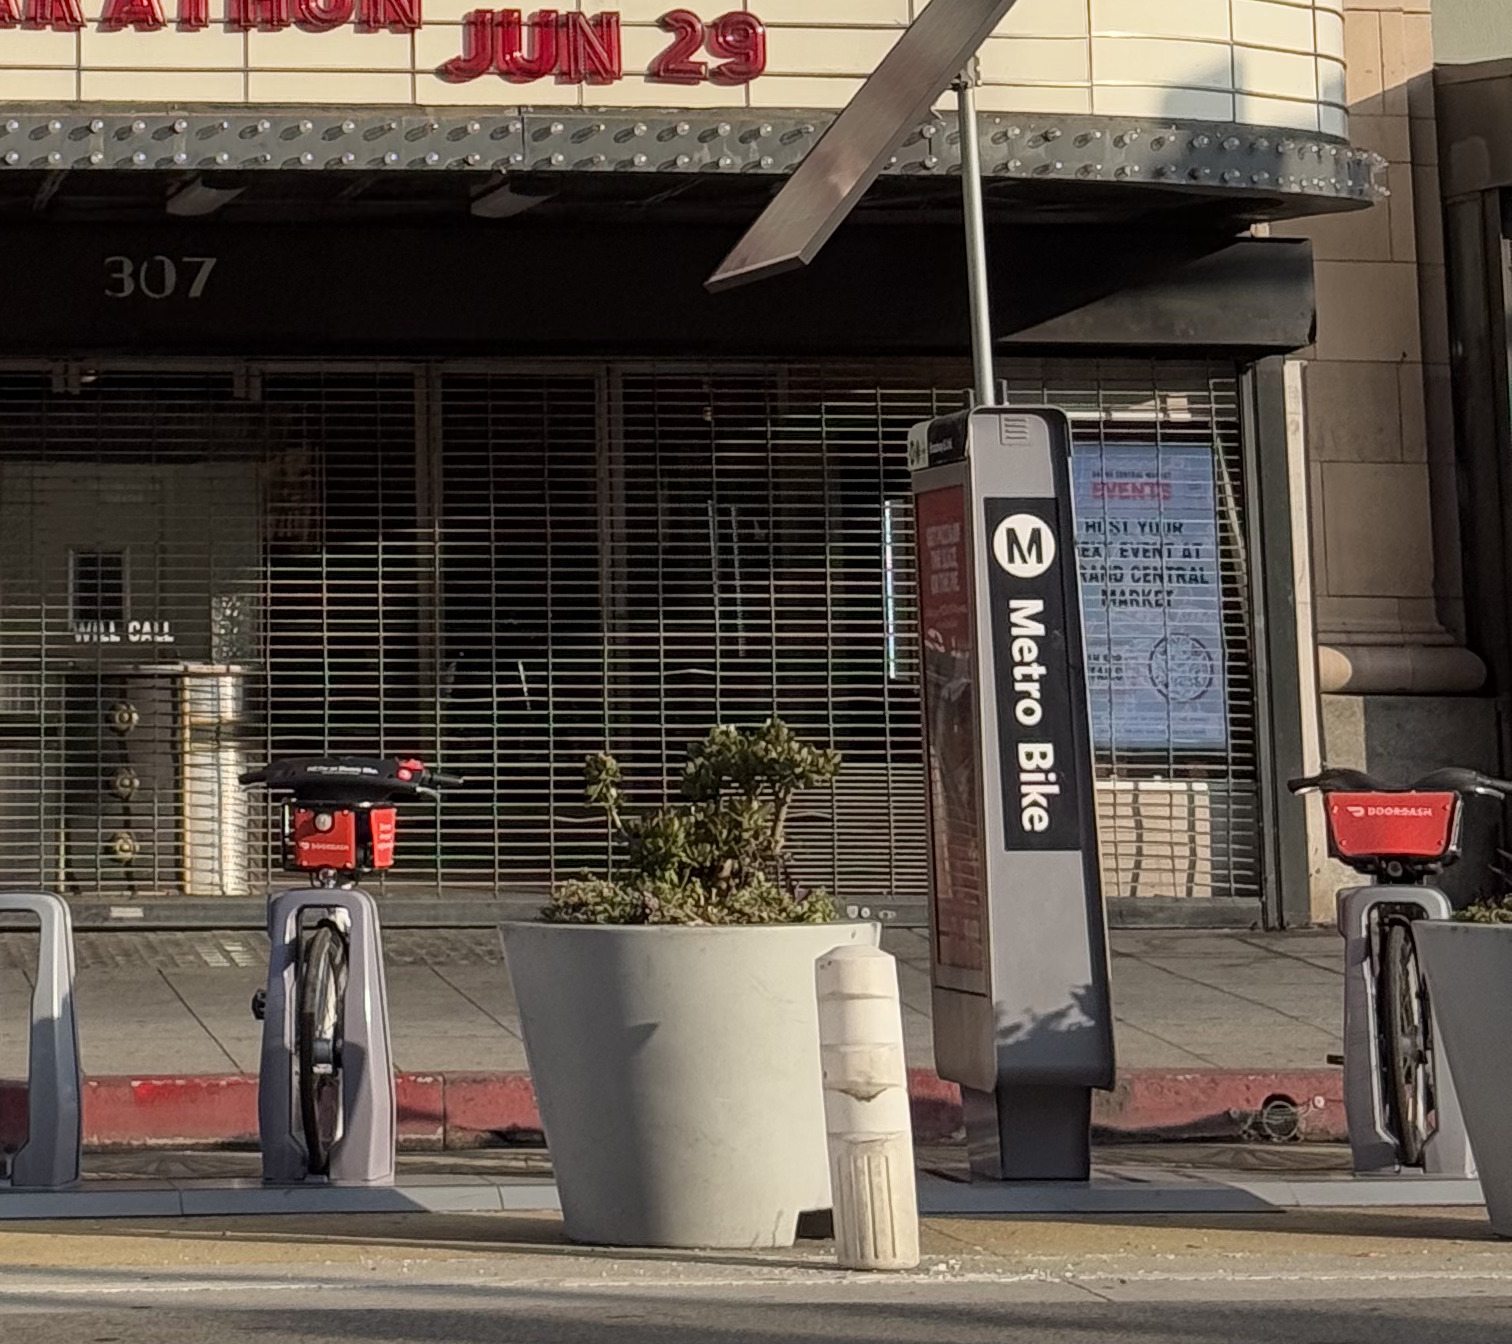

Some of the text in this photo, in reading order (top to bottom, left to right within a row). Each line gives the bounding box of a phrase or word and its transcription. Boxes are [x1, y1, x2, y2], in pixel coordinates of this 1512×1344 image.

[436, 8, 768, 84] JUN 29
[103, 255, 218, 299] 307
[1091, 482, 1172, 500] EVENTS
[1137, 517, 1185, 536] YOUR
[1005, 526, 1044, 565] M
[1119, 541, 1174, 559] EVENT
[1182, 542, 1204, 560] AT
[1079, 564, 1210, 585] RAND CENTRAL
[1100, 588, 1175, 609] MARKET
[74, 620, 175, 643] WILL CALL
[1007, 598, 1061, 834] Metro Bike
